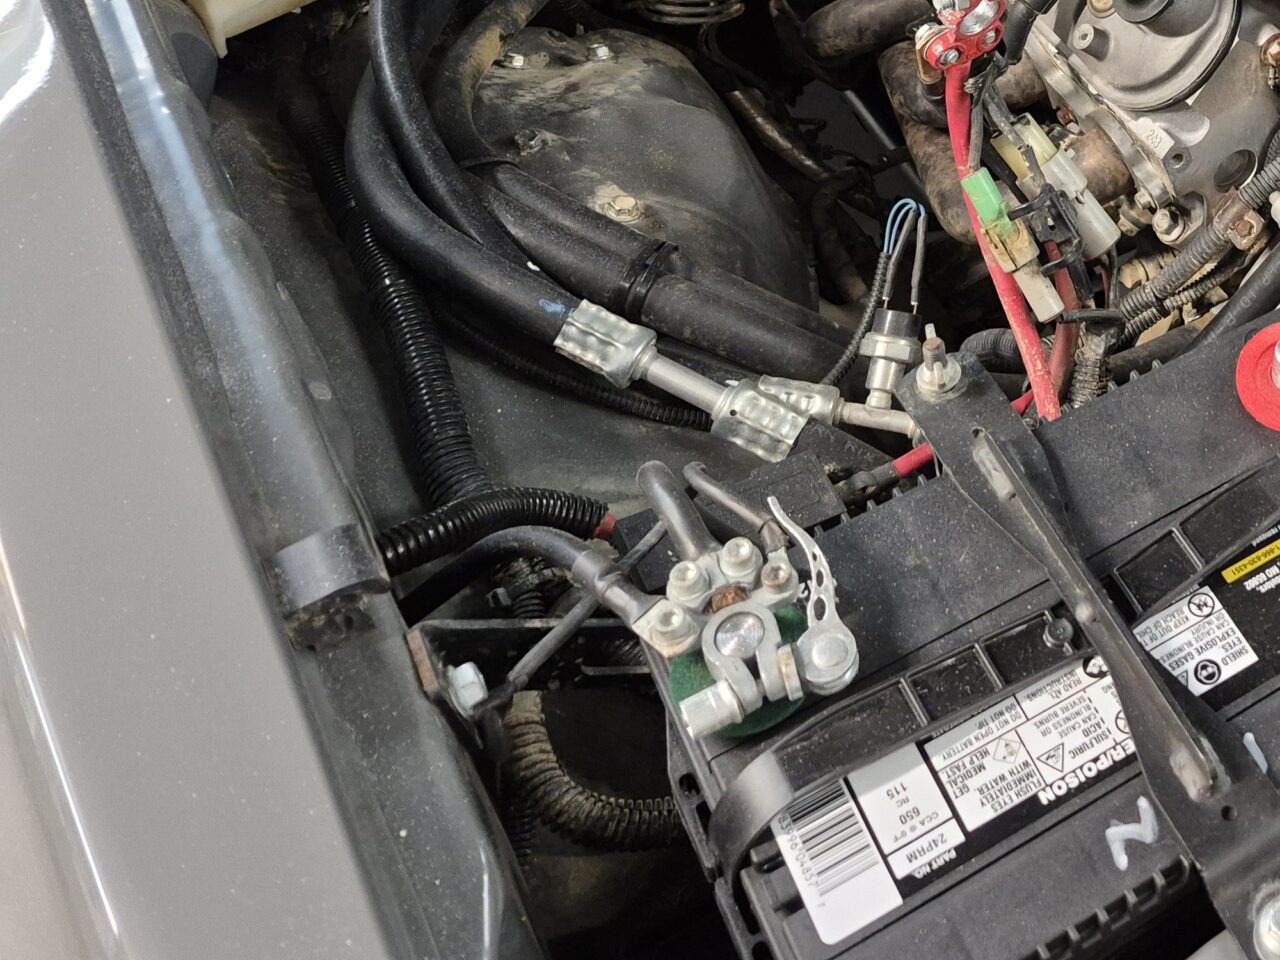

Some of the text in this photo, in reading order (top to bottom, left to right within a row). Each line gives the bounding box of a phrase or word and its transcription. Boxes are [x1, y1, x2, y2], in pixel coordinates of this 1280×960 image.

[1248, 526, 1280, 547] removed
[1229, 543, 1280, 576] 1-866-830-4351
[1241, 571, 1268, 591] 65802
[1262, 564, 1280, 578] MO
[1160, 606, 1186, 625] REACH
[1169, 614, 1190, 629] KEEP
[1213, 611, 1226, 621] OR
[1213, 618, 1231, 631] CAN
[1155, 623, 1174, 637] OUT
[1192, 626, 1217, 643] CAUSE
[1156, 639, 1194, 664] BLINDNES
[1166, 626, 1237, 671] EXPLOSIVE GASES
[1217, 635, 1243, 654] EYES.
[1218, 644, 1250, 666] SHIELD
[1022, 668, 1077, 703] INSTRUCTIONS.
[1062, 677, 1082, 692] READ
[1058, 694, 1086, 714] SEVERE
[974, 702, 1017, 730] DO NOT TIP.
[993, 717, 1010, 731] NOT
[1009, 710, 1022, 722] DO
[1039, 702, 1092, 737] BLINDNESS OR
[1057, 711, 1097, 738] CAN CAUSE
[972, 725, 994, 742] OPEN
[1080, 719, 1103, 738] ACID
[938, 736, 974, 762] BATTERY.
[1067, 729, 1109, 759] SULFURIC
[941, 746, 990, 780] HELP FAST.
[945, 760, 986, 790] MEDICAL
[973, 758, 1031, 797] WITH WATER.
[884, 781, 908, 800] 115
[951, 782, 970, 799] GET
[978, 767, 1036, 807] IMMEDIATELY
[990, 776, 1042, 813] FLUSH EYES
[895, 795, 910, 808] RC
[897, 805, 921, 825] 650
[918, 810, 939, 827] CCA
[904, 832, 947, 864] 24PRM
[910, 847, 957, 882] PART NO.
